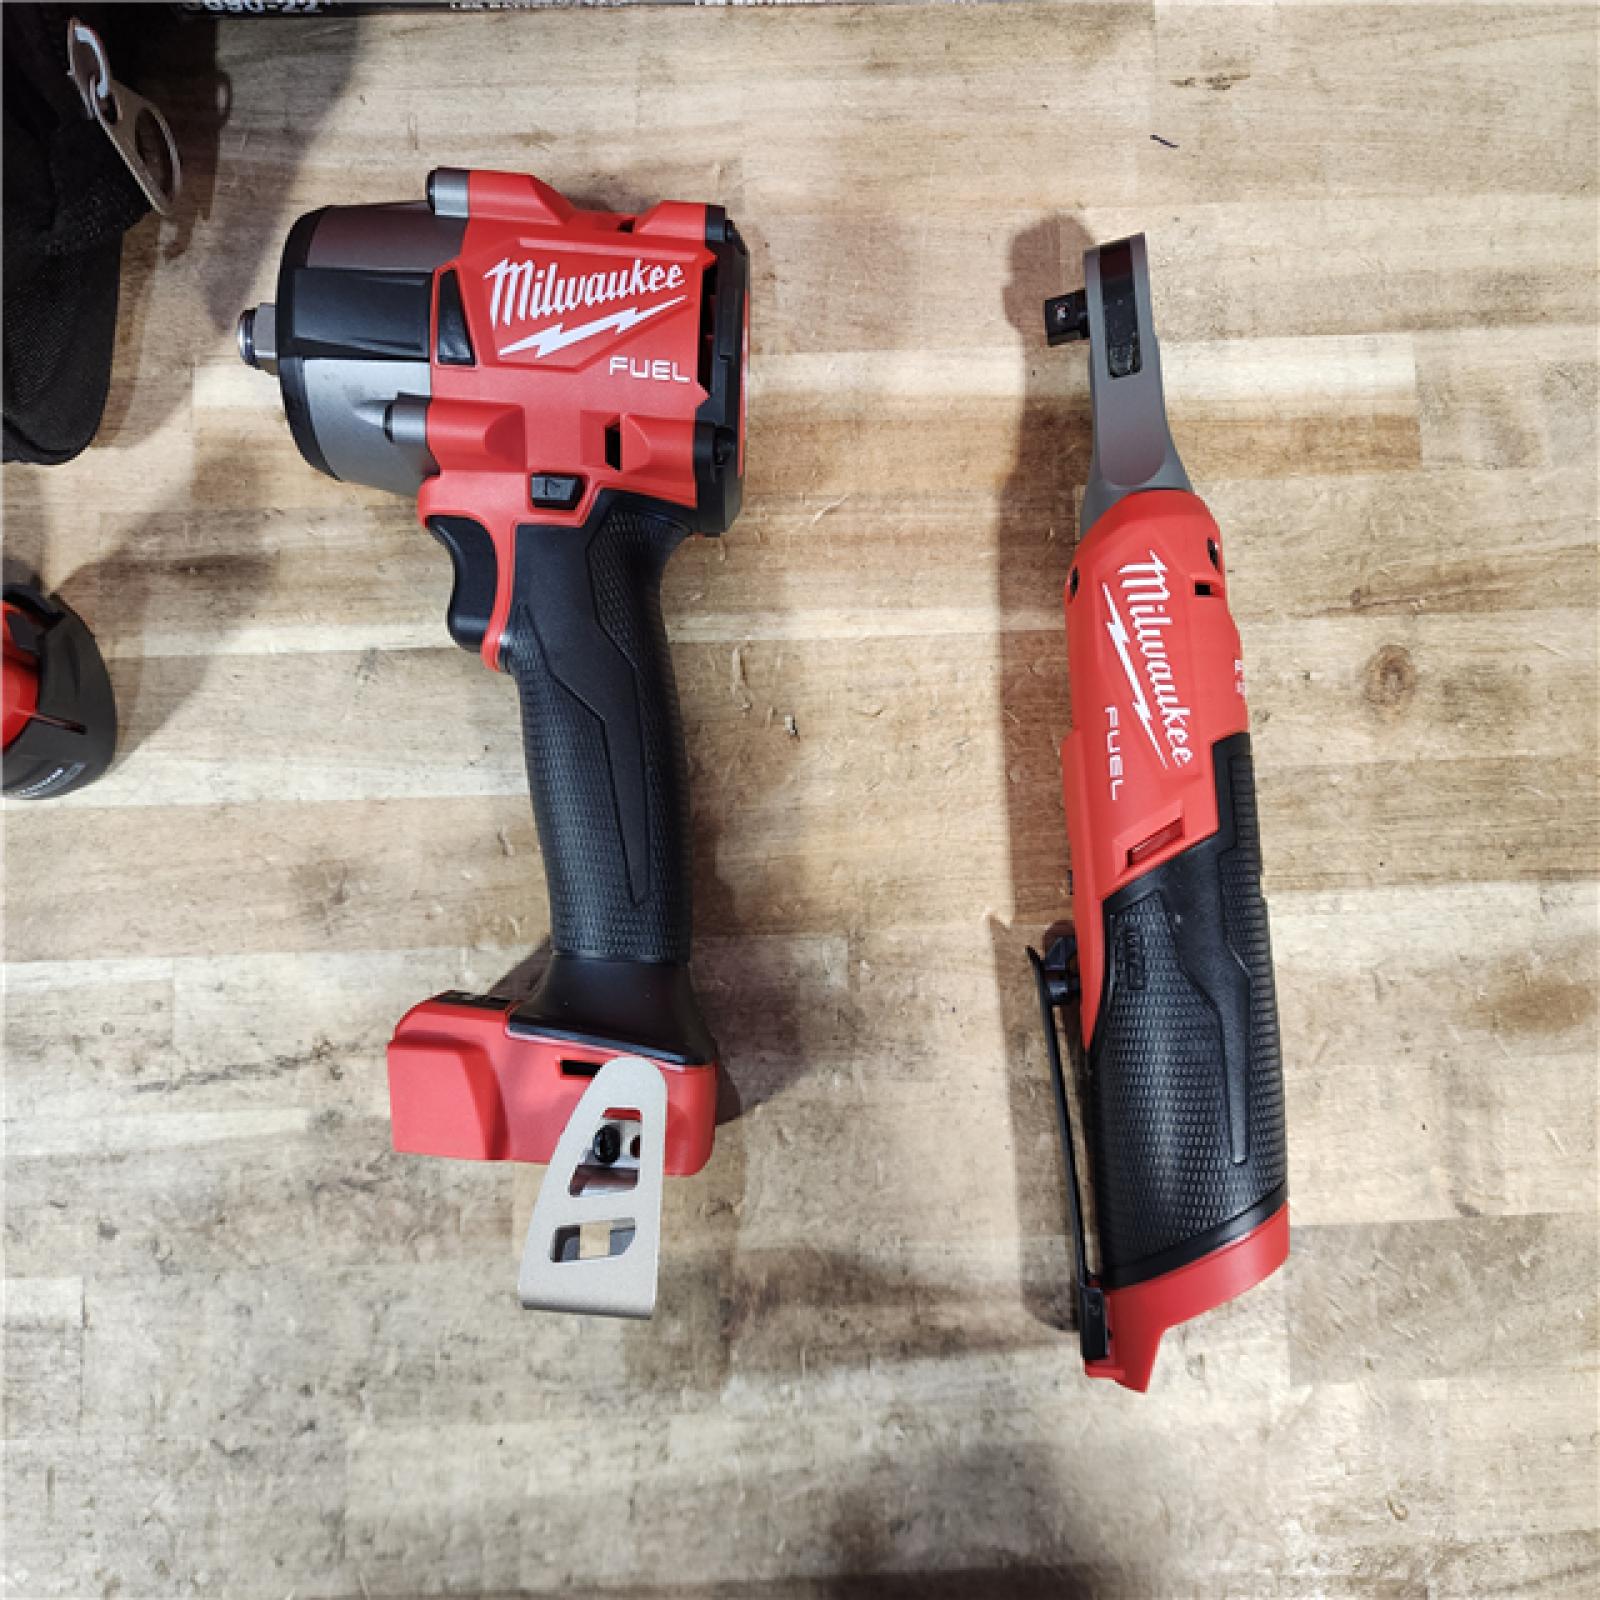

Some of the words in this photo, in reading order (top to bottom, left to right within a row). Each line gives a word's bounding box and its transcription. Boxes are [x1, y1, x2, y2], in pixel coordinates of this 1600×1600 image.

[483, 257, 686, 330] Milwaukee
[609, 355, 691, 383] FUEL
[1117, 549, 1194, 768] Milwaukee
[1104, 706, 1125, 801] FUEL
